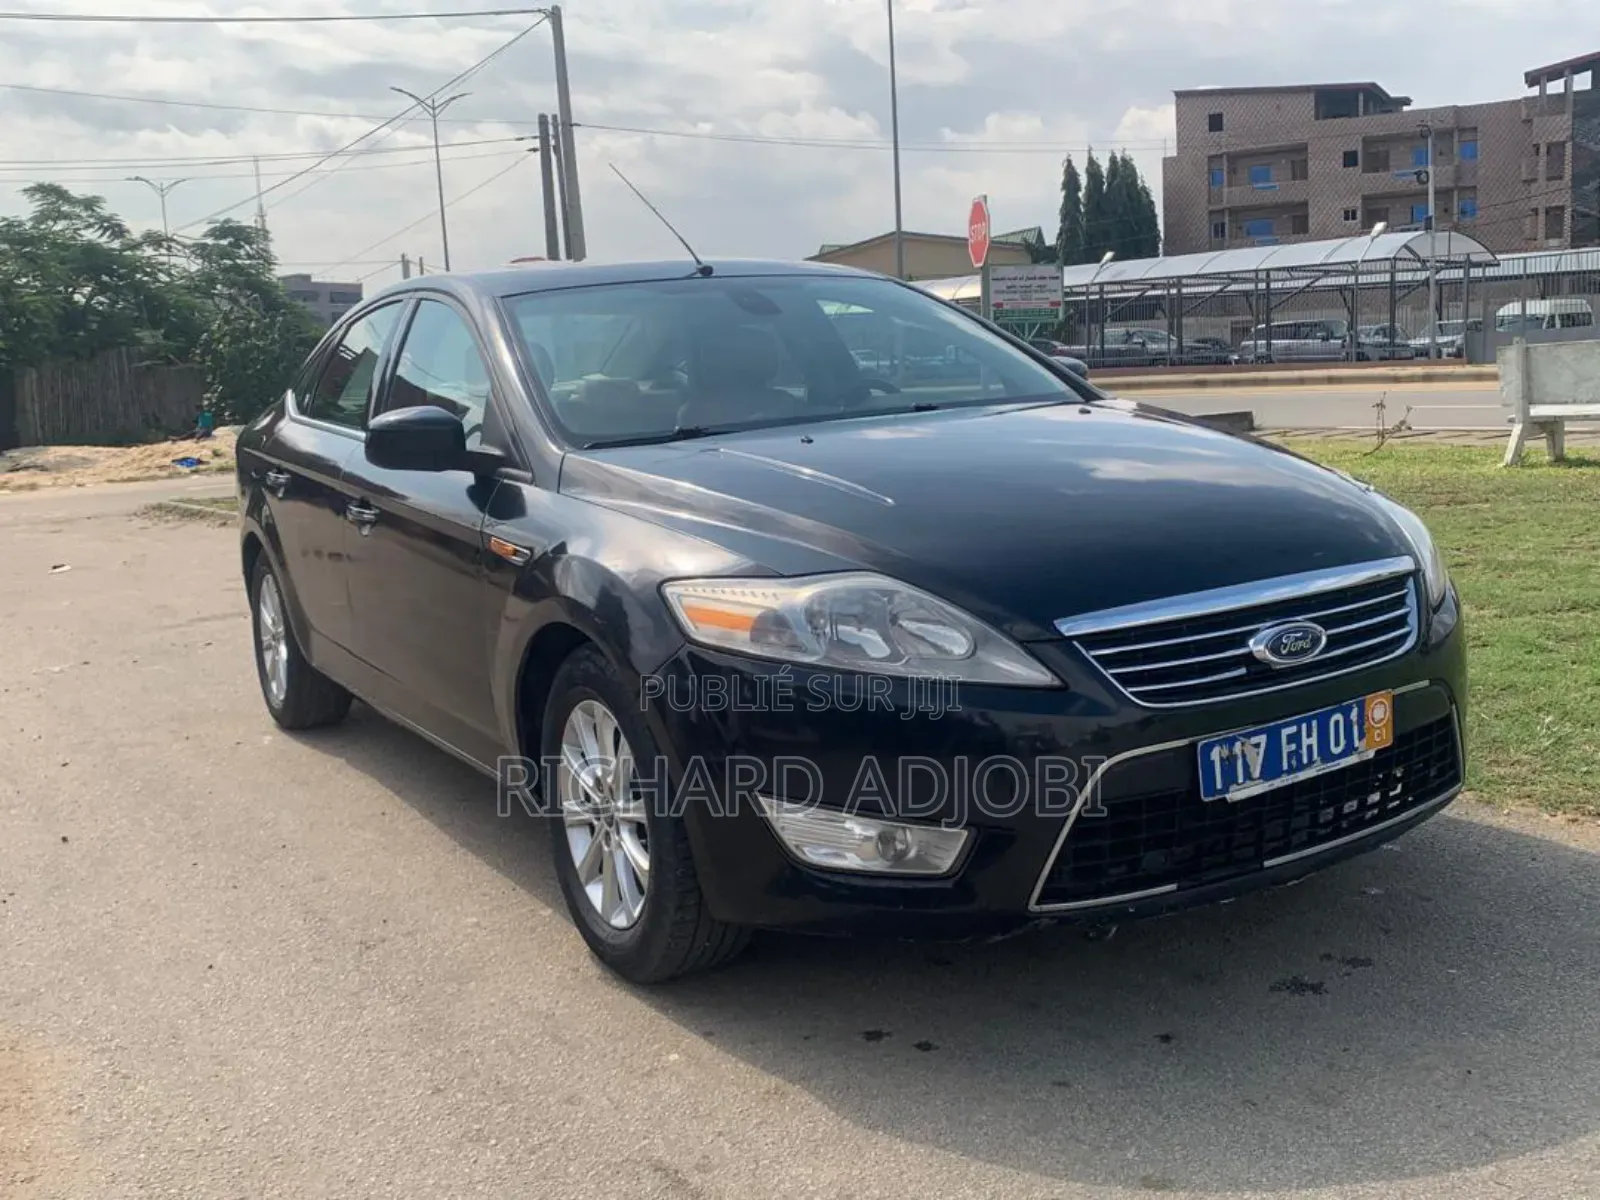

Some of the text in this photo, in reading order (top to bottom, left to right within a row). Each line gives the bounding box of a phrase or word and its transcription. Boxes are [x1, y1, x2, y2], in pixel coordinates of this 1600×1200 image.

[971, 221, 986, 243] STOP
[1280, 631, 1312, 655] Ford
[1210, 703, 1360, 790] 117 FH 01
[1374, 728, 1387, 743] CI
